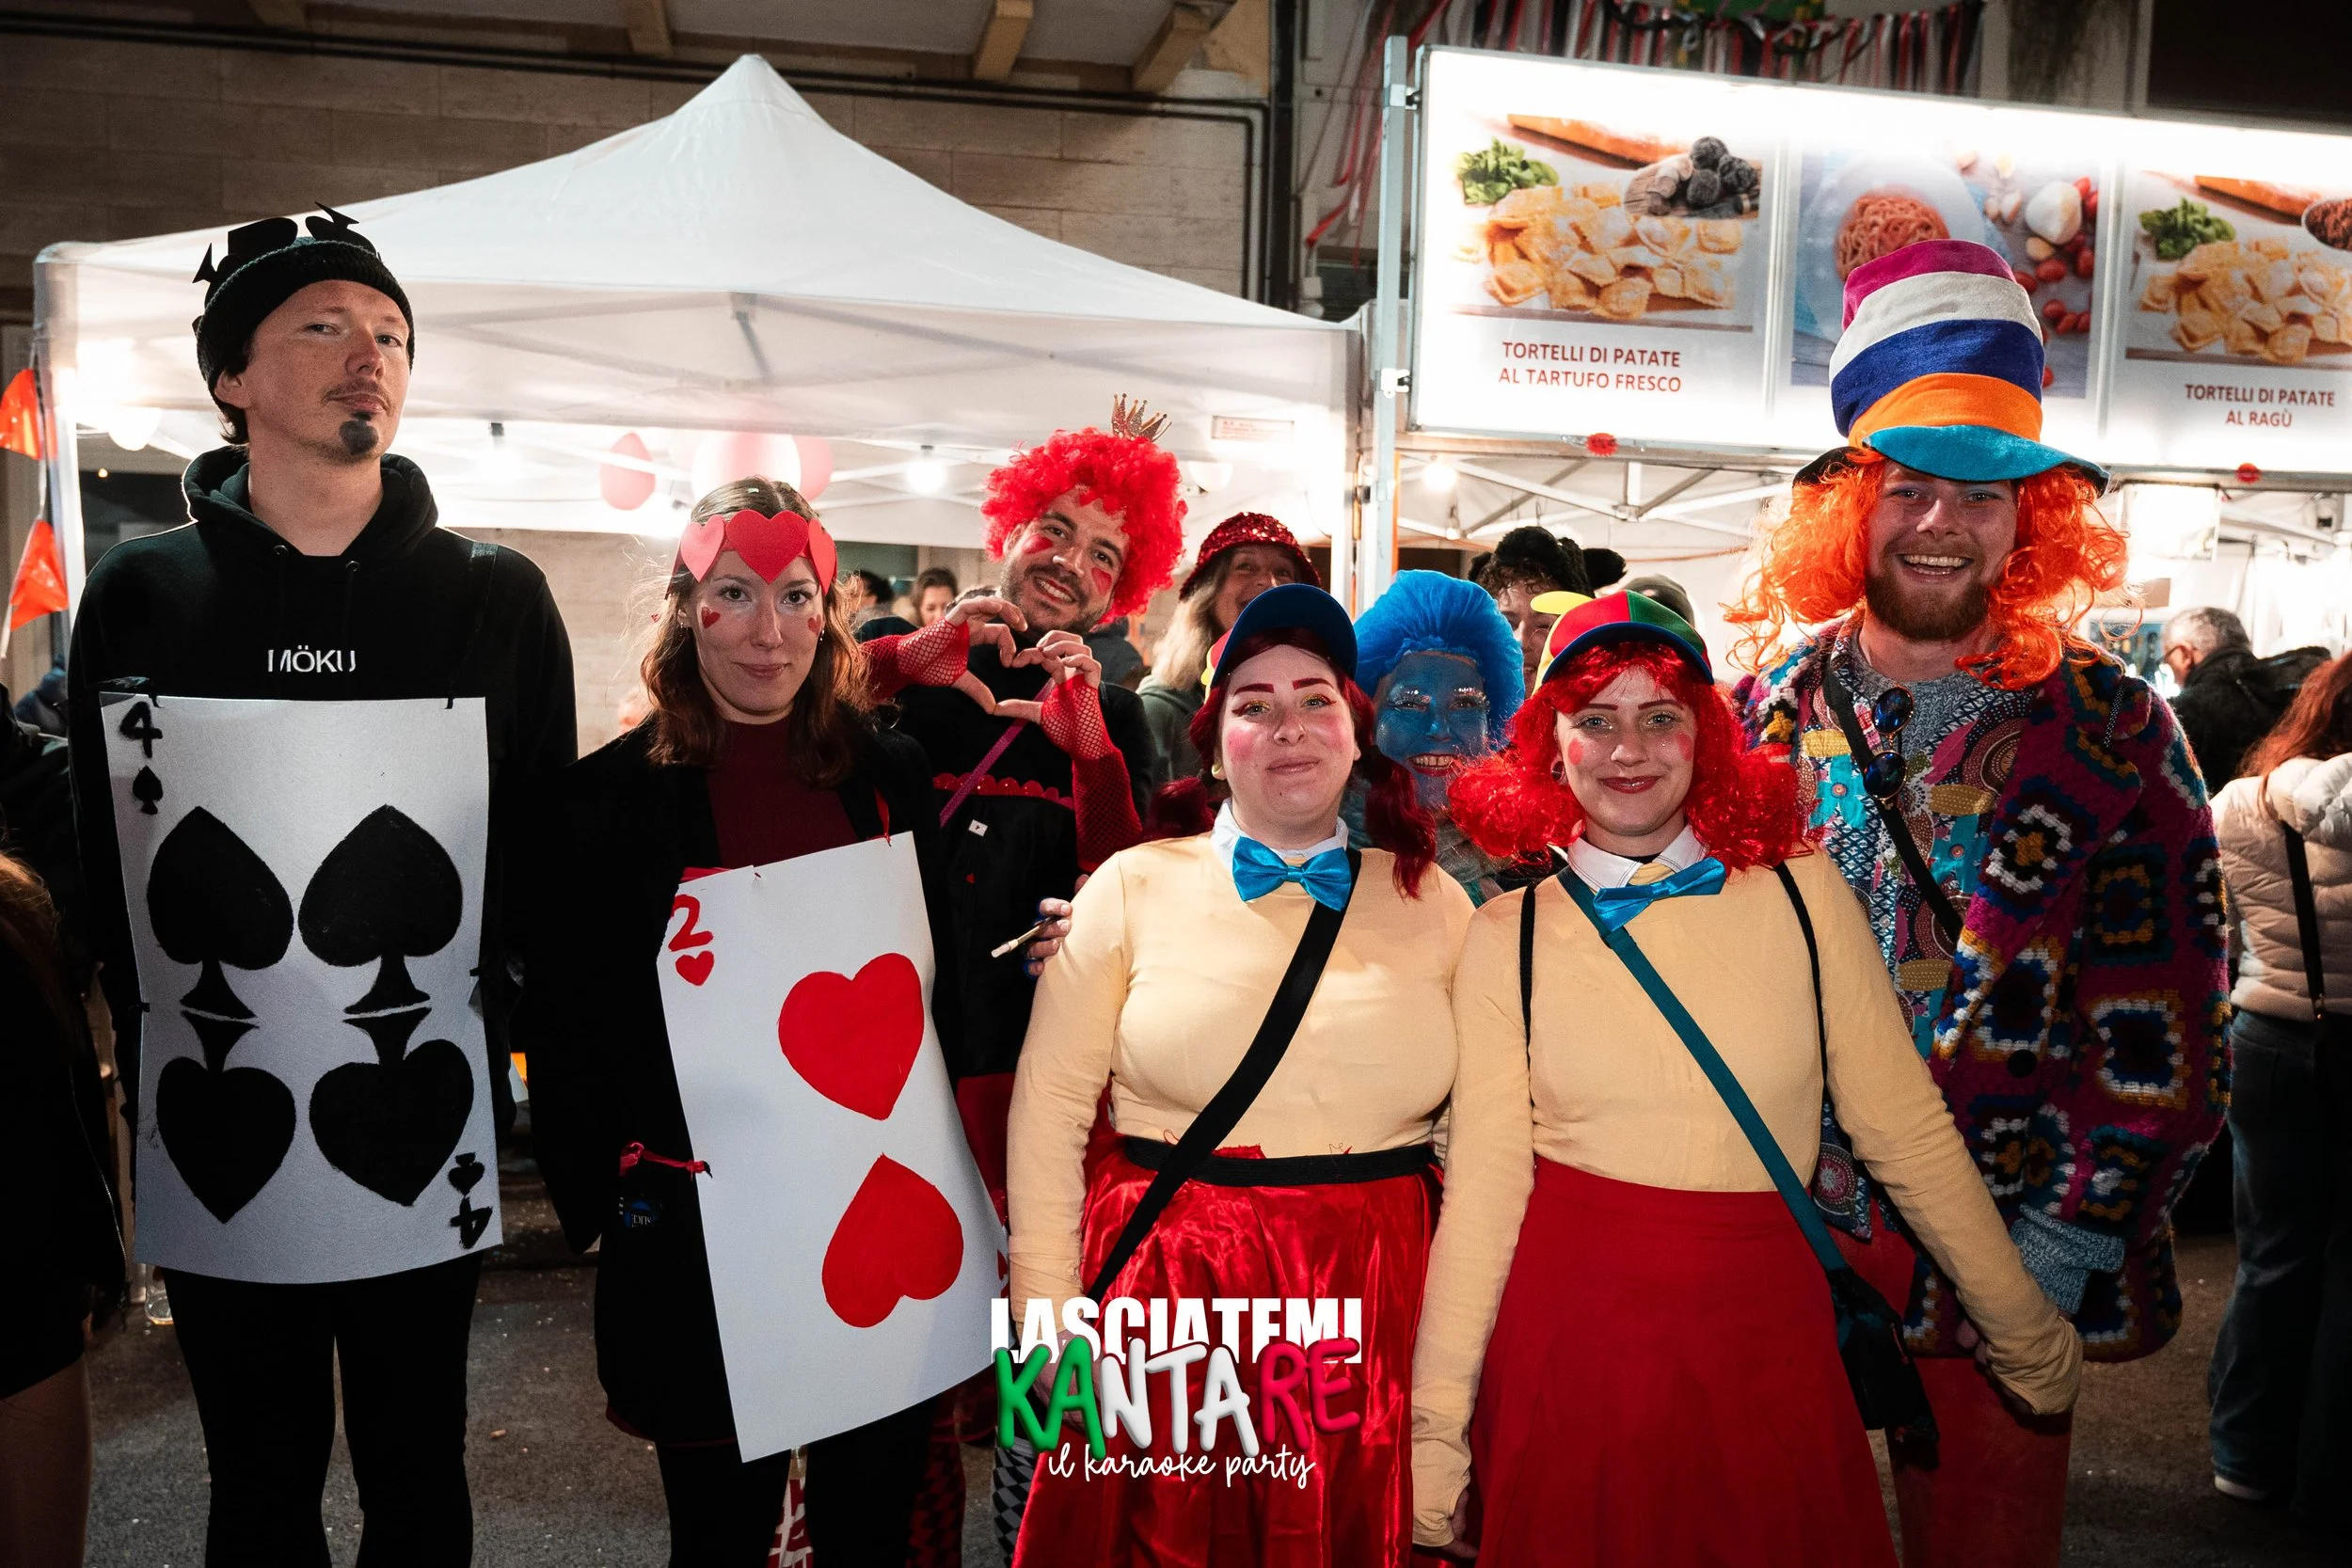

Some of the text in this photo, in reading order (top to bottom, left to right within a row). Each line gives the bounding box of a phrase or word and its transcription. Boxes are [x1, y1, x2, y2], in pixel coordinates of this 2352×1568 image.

[1502, 341, 1680, 368] TORTELLI DI PATATE
[1499, 368, 1681, 392] AL TARTUFO FRESCO
[2185, 384, 2335, 406] TORTELLI DI PATATE
[2225, 409, 2293, 427] AL RAGÙ
[268, 644, 356, 673] MÖKU
[119, 701, 164, 759] 4
[668, 894, 714, 952] 2
[450, 1196, 494, 1249] 4
